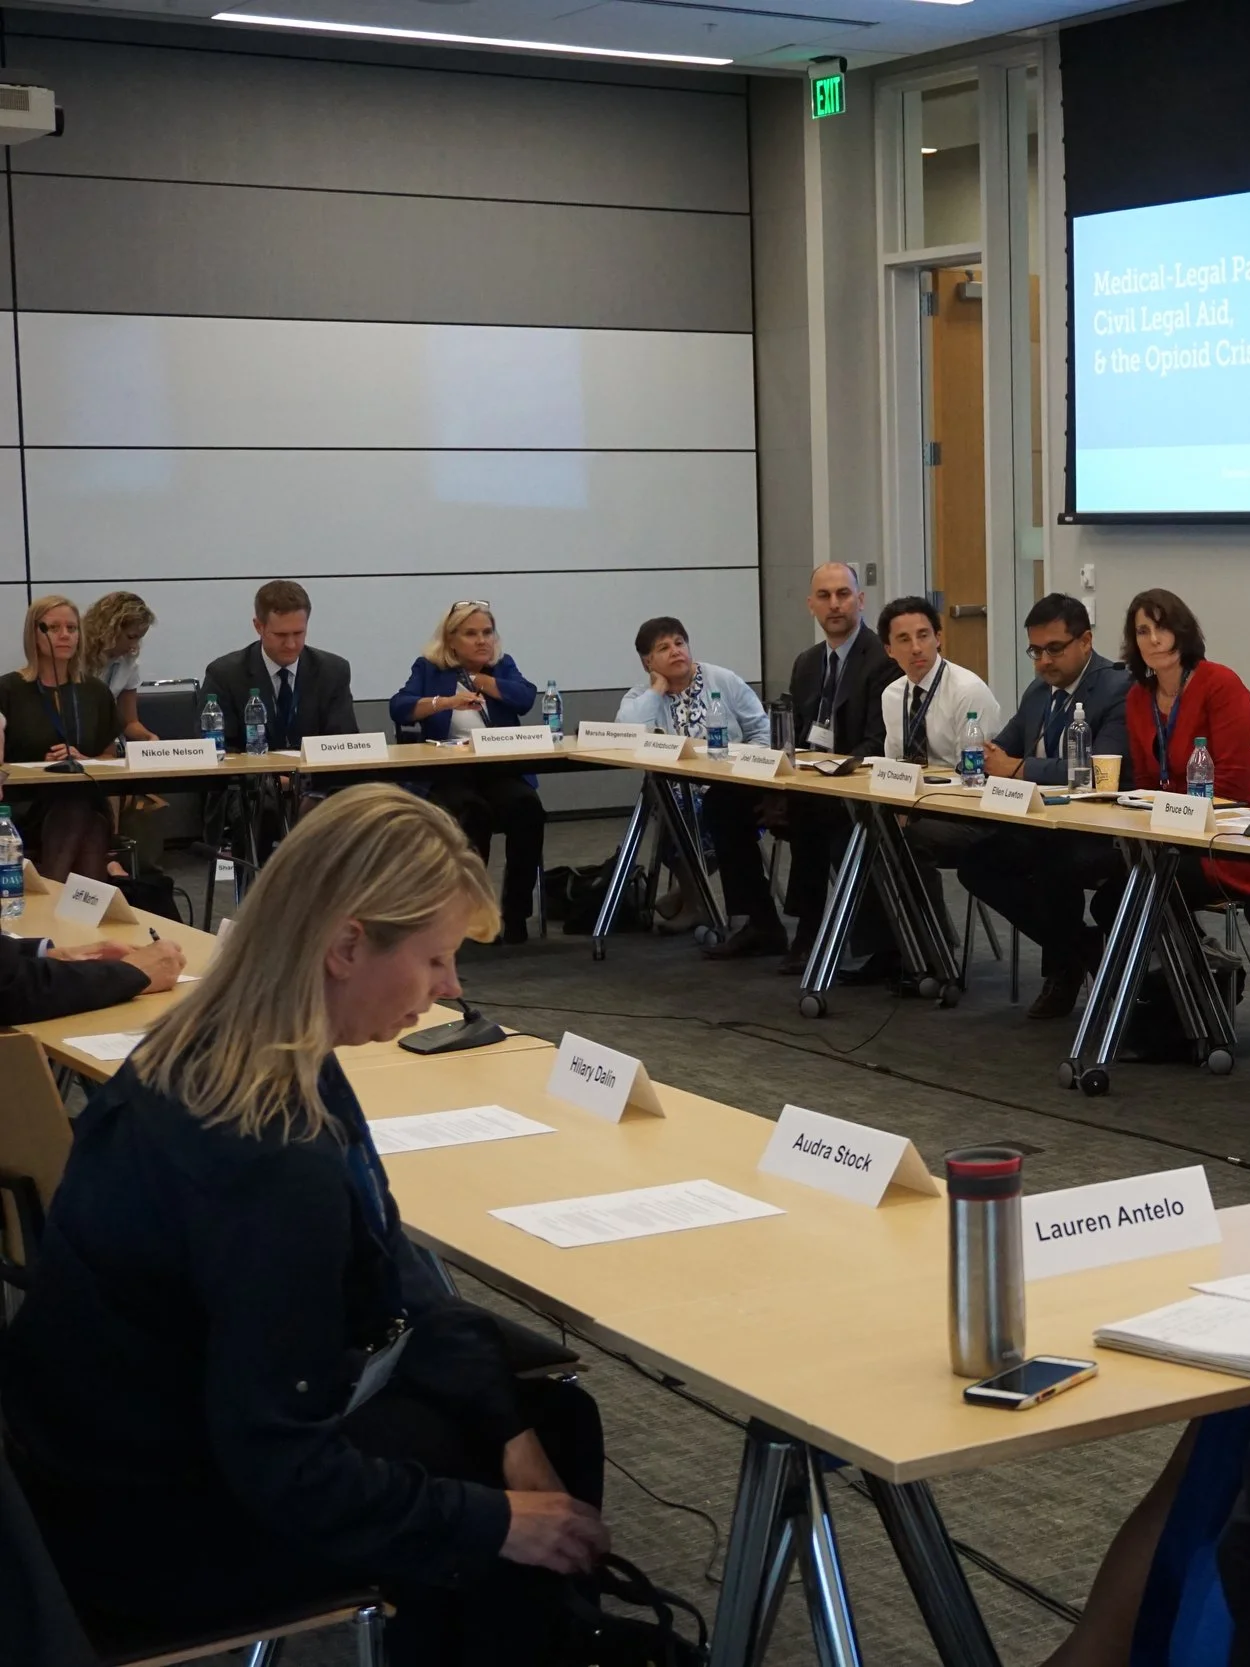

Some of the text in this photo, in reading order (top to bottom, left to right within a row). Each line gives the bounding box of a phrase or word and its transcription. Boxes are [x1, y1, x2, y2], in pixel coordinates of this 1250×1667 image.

[816, 76, 841, 116] EXIT
[1093, 257, 1226, 296] Medical-Legal
[1094, 298, 1234, 337] Civil Legal Aid,
[1094, 350, 1106, 375] &
[1111, 347, 1141, 374] the
[1145, 340, 1211, 377] Opioid
[480, 732, 543, 743] Rebecca Weaver
[584, 729, 606, 738] Marsha
[142, 747, 204, 758] Nikole Nelson
[321, 741, 371, 752] David Bates
[877, 769, 886, 780] Jay
[992, 786, 1024, 800] Ellen Lawton
[1165, 802, 1194, 816] Bruce Ohr
[570, 1055, 616, 1088] Hilary Dalin
[792, 1133, 872, 1172] Audra Stock
[1035, 1198, 1184, 1241] Lauren Antelo
